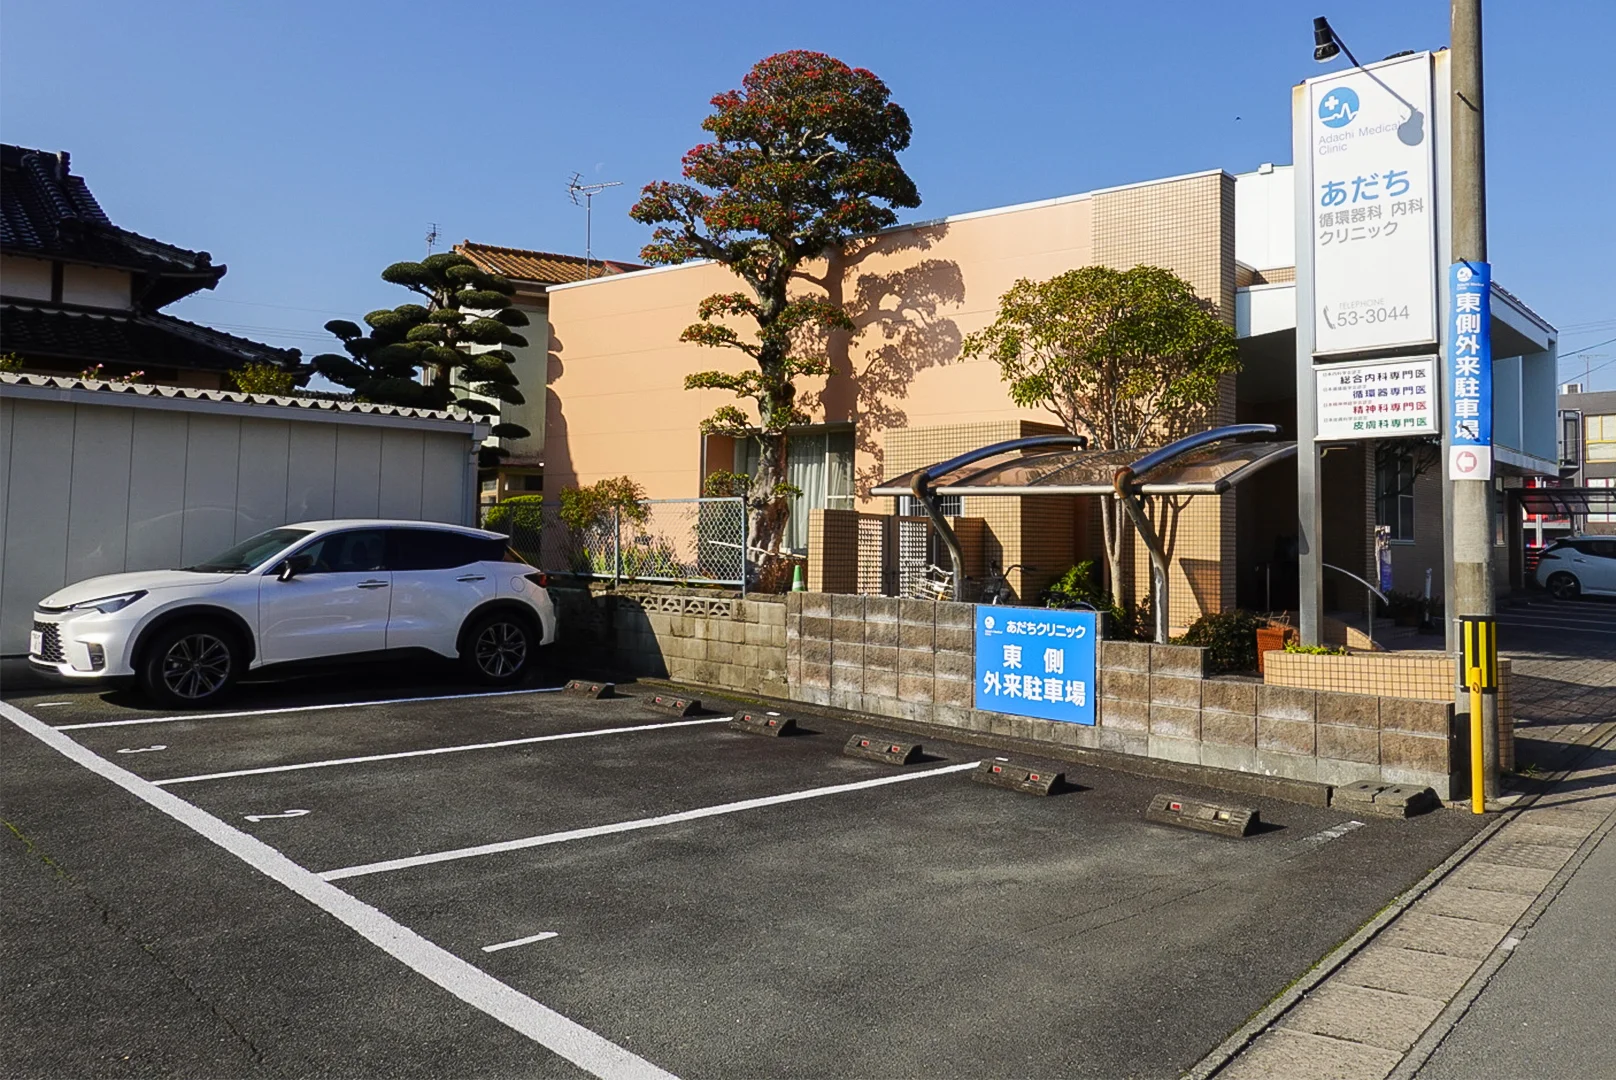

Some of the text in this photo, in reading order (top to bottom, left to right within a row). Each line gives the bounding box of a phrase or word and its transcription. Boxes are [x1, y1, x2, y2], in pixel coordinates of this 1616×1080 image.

[1318, 129, 1355, 145] Adachi
[1318, 143, 1348, 156] Clinic
[1320, 169, 1410, 207] あだち
[1319, 197, 1424, 228] 循環器科 内科
[1319, 220, 1398, 246] クリニック
[1338, 297, 1386, 310] TELEPHONE
[1337, 304, 1410, 327] 53-3044
[1454, 292, 1481, 441] 東側外来駐車場
[1340, 368, 1426, 385] 総合内科専門医
[1352, 384, 1427, 400] 循環器専門医
[1353, 401, 1427, 415] 精神科専門医
[1353, 416, 1428, 431] 皮膚科専門医
[1006, 620, 1086, 639] あだちクリニック
[983, 670, 1086, 707] 外来駐車場
